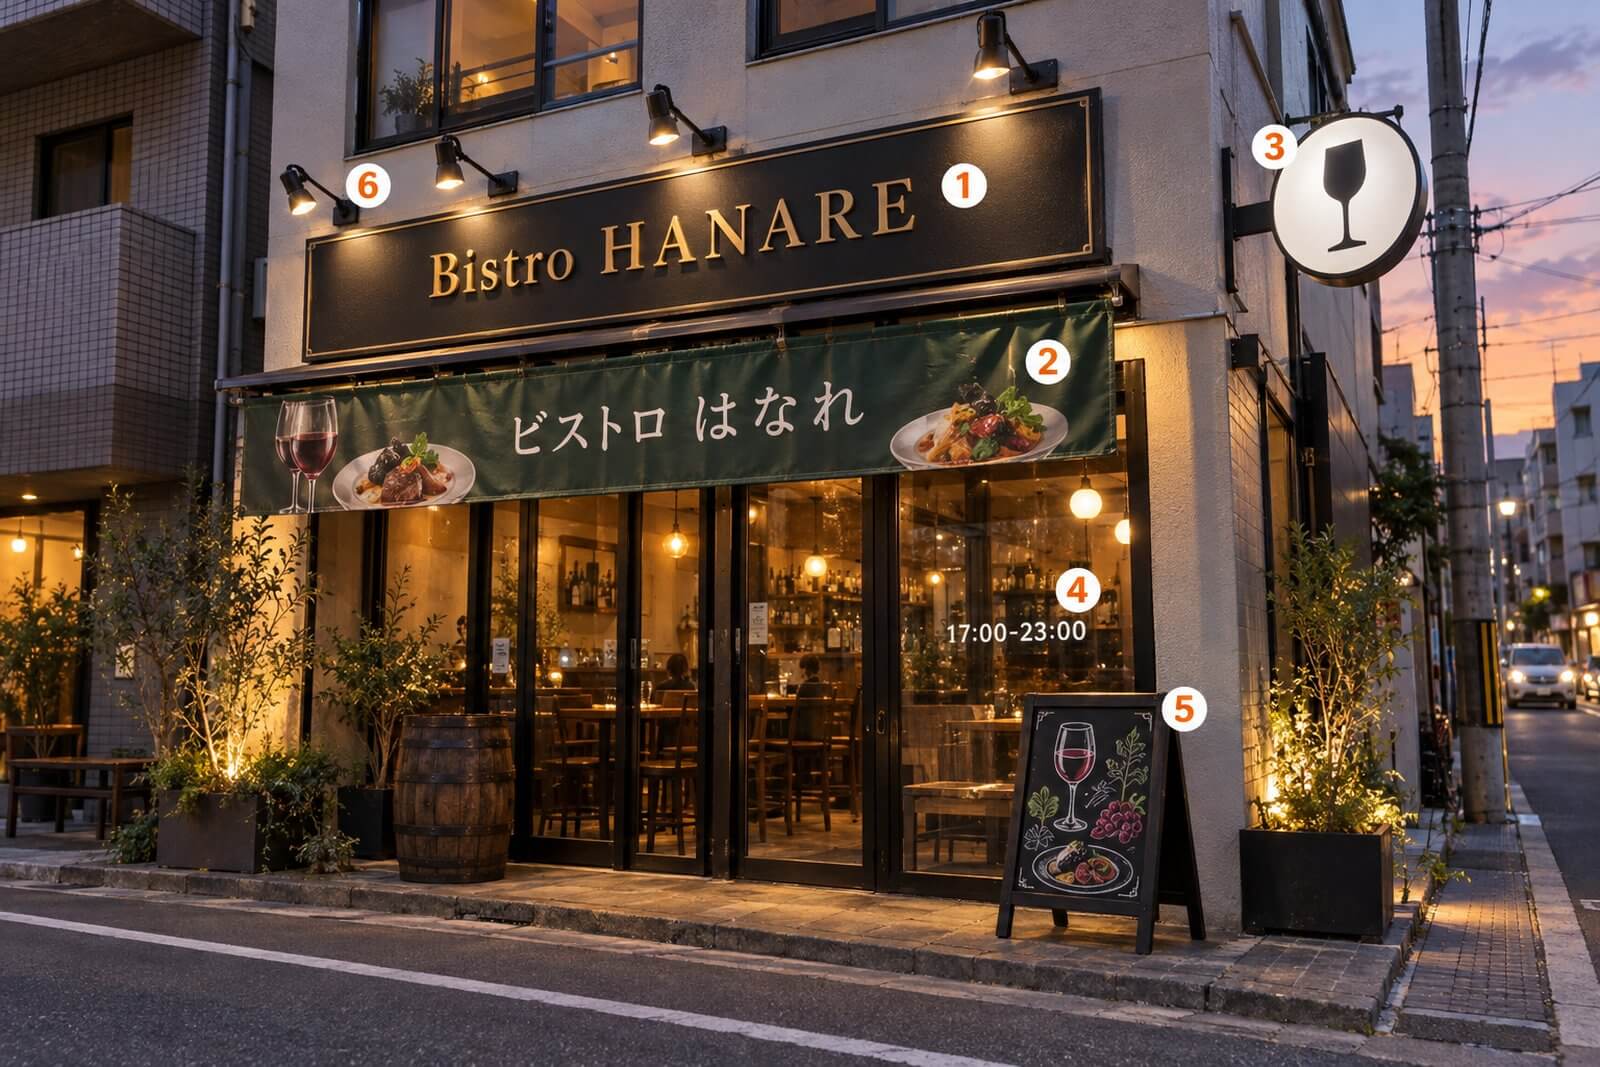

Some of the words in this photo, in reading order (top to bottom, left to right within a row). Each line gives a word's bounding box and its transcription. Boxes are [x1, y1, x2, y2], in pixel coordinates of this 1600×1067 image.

[429, 248, 574, 298] Bistro
[602, 177, 916, 275] HANARE
[514, 405, 666, 456] ビストロ
[695, 381, 864, 442] はなれ
[947, 620, 1087, 644] 17:00-23:00
